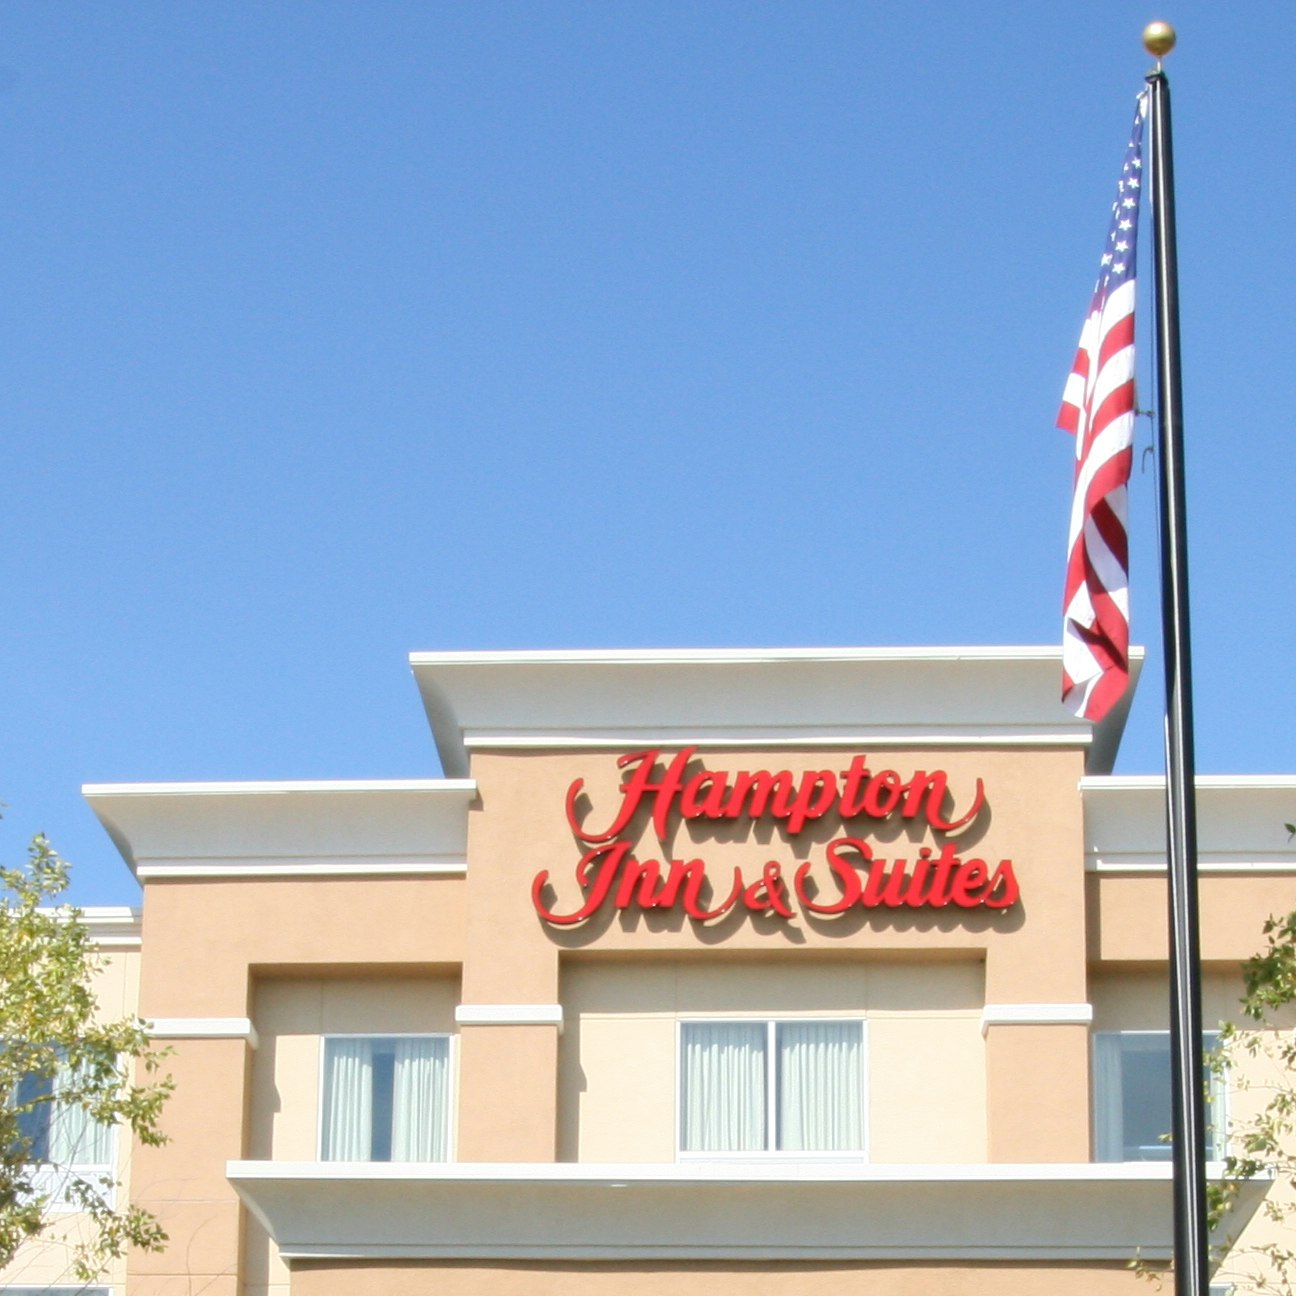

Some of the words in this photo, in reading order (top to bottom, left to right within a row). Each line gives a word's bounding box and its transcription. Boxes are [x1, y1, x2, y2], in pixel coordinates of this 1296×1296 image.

[565, 745, 985, 843] Hampton
[531, 840, 743, 924] Inn
[743, 861, 796, 918] &
[794, 836, 1020, 914] Suites
